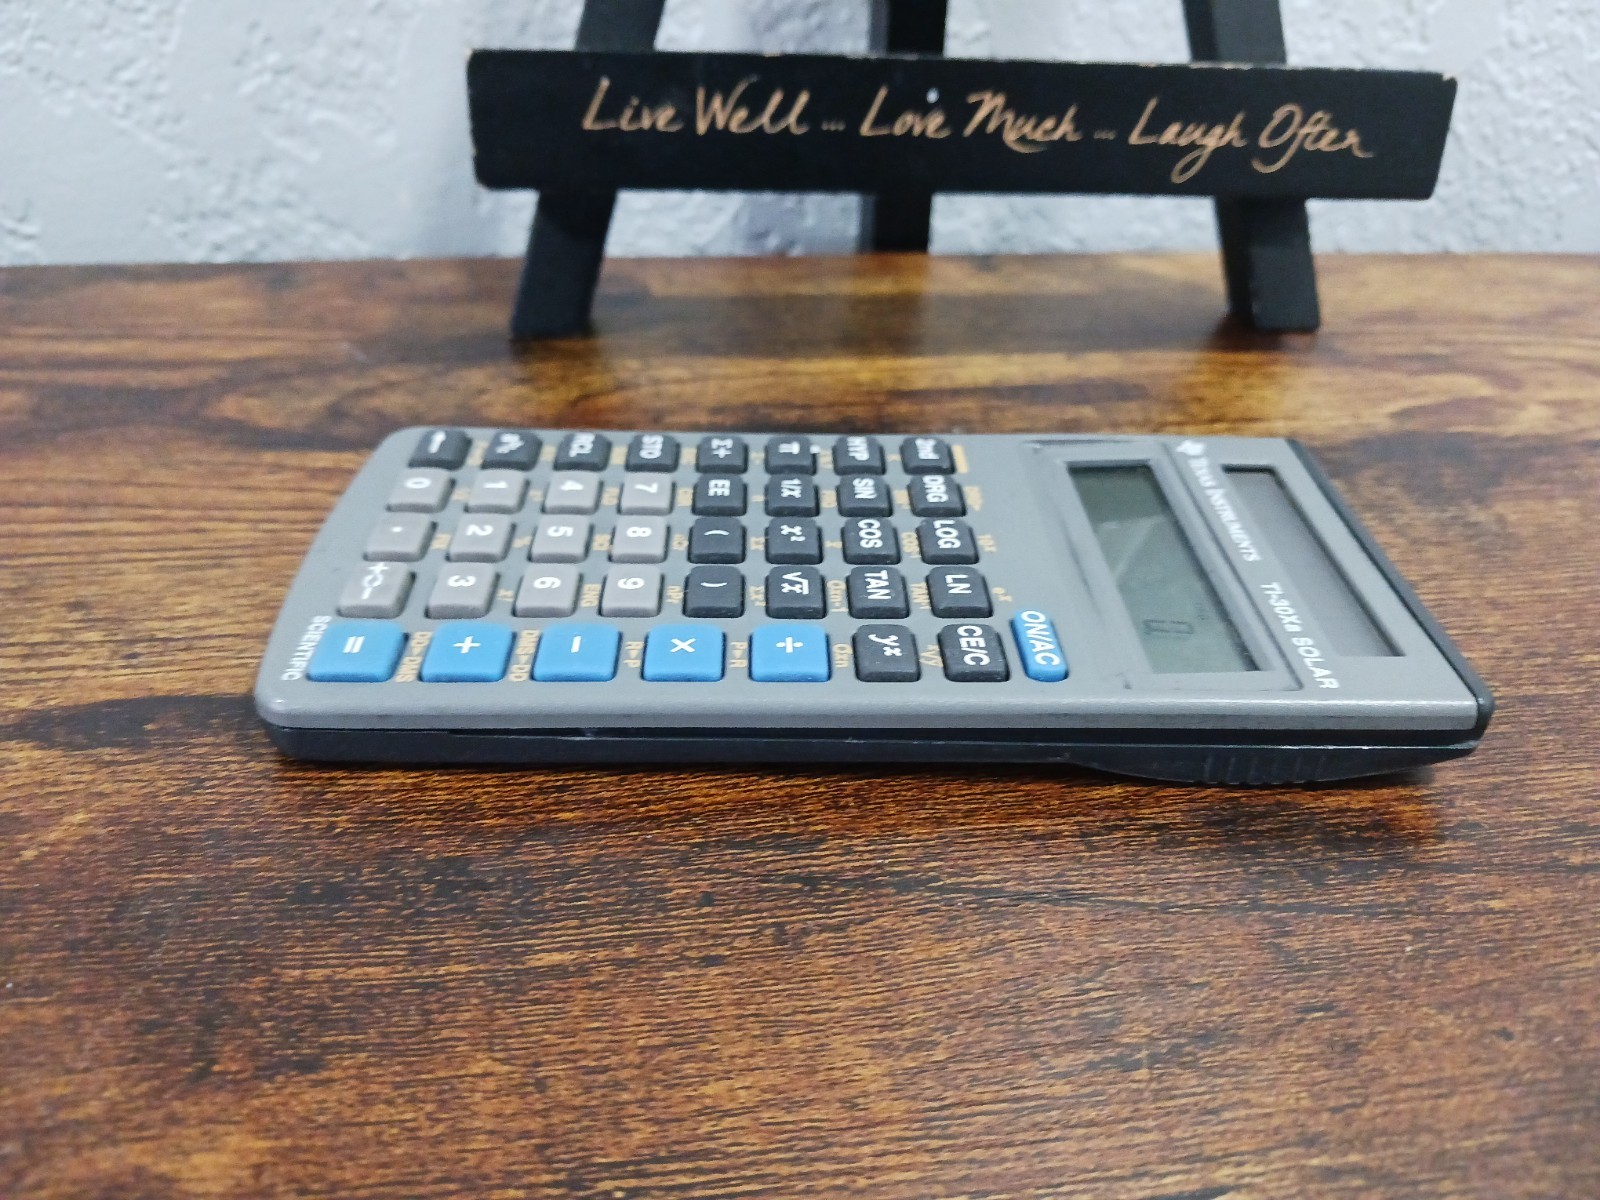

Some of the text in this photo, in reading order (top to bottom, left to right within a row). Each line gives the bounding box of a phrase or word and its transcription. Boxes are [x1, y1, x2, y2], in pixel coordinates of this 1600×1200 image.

[582, 75, 684, 131] Live
[696, 73, 811, 135] Well
[859, 85, 953, 139] Love
[963, 90, 1084, 154] Much
[1128, 96, 1249, 184] Laugh
[568, 432, 596, 457] RCL
[639, 434, 665, 459] STO
[847, 436, 870, 460] HYP
[914, 438, 940, 460] 2nd
[404, 477, 431, 490] 0
[483, 480, 508, 490] 1
[560, 480, 585, 491] 4
[635, 482, 658, 494] 7
[707, 479, 731, 497] EE
[852, 477, 878, 500] SIN
[922, 474, 949, 503] DRG
[465, 524, 493, 536] 2
[547, 526, 575, 538] 5
[627, 526, 653, 538] 8
[857, 518, 885, 549] COS
[932, 520, 962, 549] LOG
[447, 575, 477, 588] 3
[533, 577, 562, 589] 6
[617, 577, 646, 590] 9
[864, 570, 892, 600] TAN
[945, 574, 973, 594] LN
[580, 583, 602, 608] ENG
[343, 635, 366, 654] =
[452, 635, 481, 654] +
[957, 624, 991, 667] CE/C
[1020, 609, 1062, 666] ON/AC
[1260, 581, 1340, 690] TI-30Xa SOLAR
[280, 615, 333, 681] SCIENTIFIC
